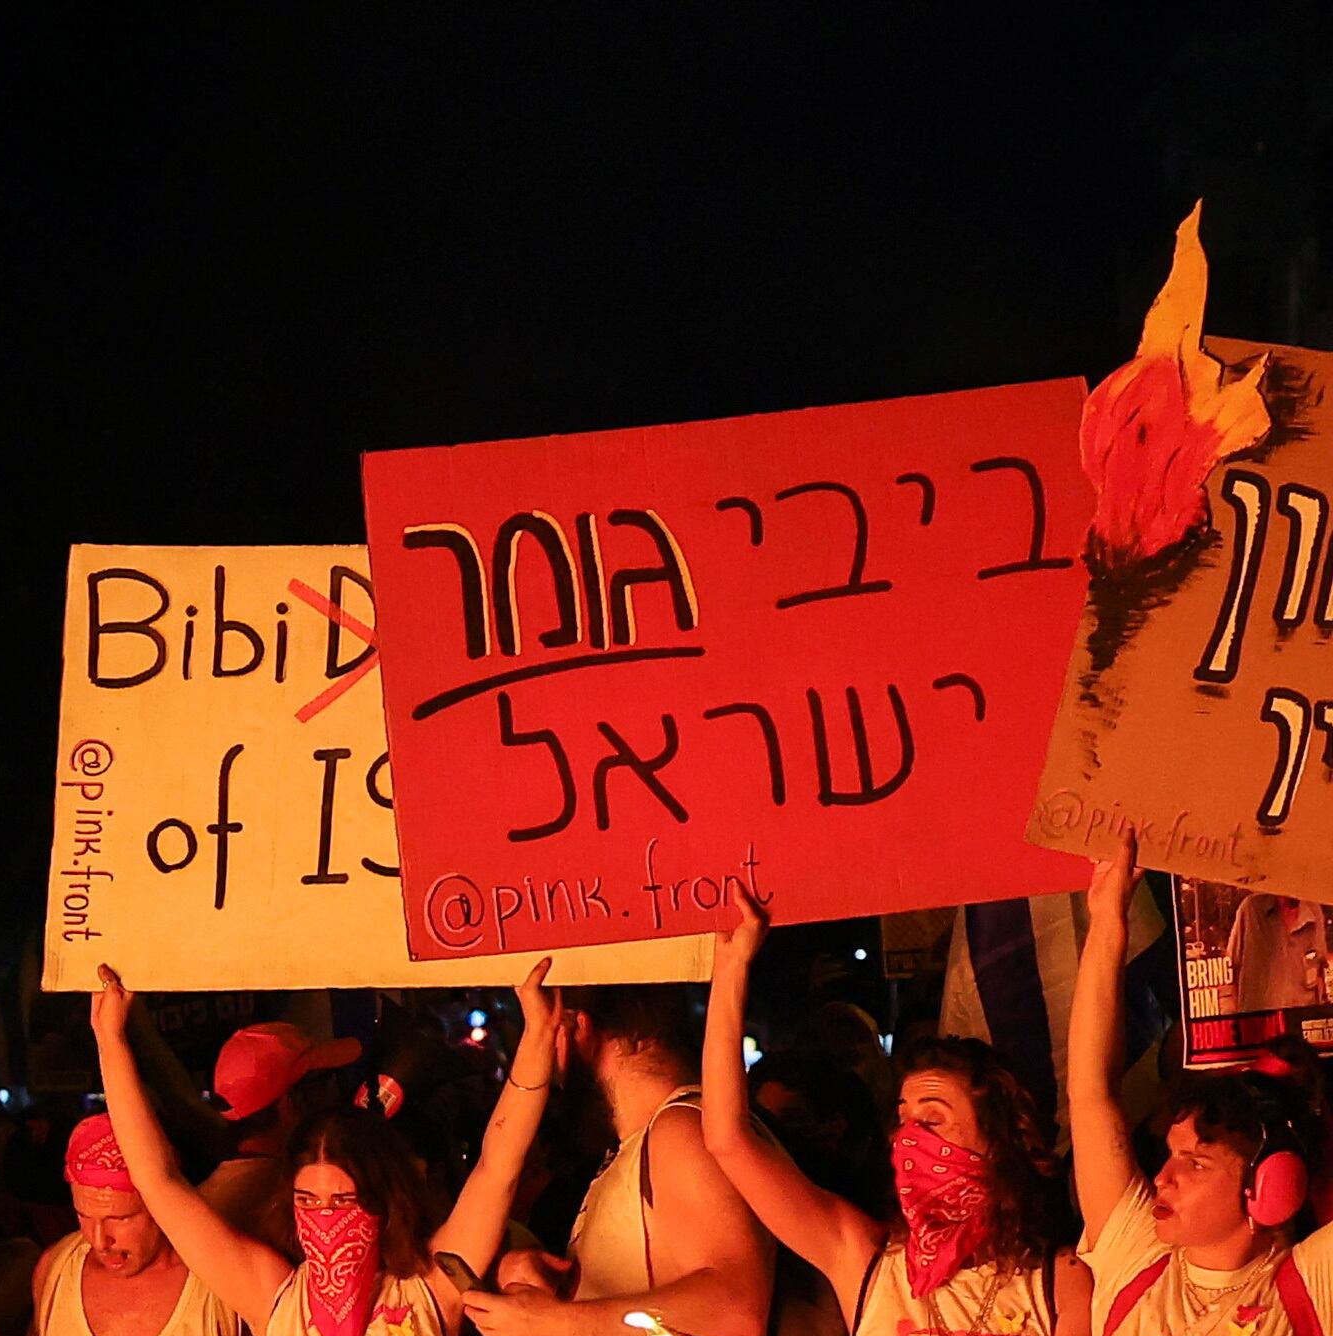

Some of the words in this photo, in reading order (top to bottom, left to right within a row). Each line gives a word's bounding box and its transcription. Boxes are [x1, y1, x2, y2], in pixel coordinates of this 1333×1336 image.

[403, 509, 699, 660] גומר
[716, 456, 1073, 609] ביבי
[88, 565, 289, 689] Bibi
[147, 744, 243, 910] of
[498, 673, 986, 842] ישראל
[61, 738, 115, 942] @pink.front
[1186, 956, 1233, 989] BRING
[1189, 988, 1219, 1019] HIM
